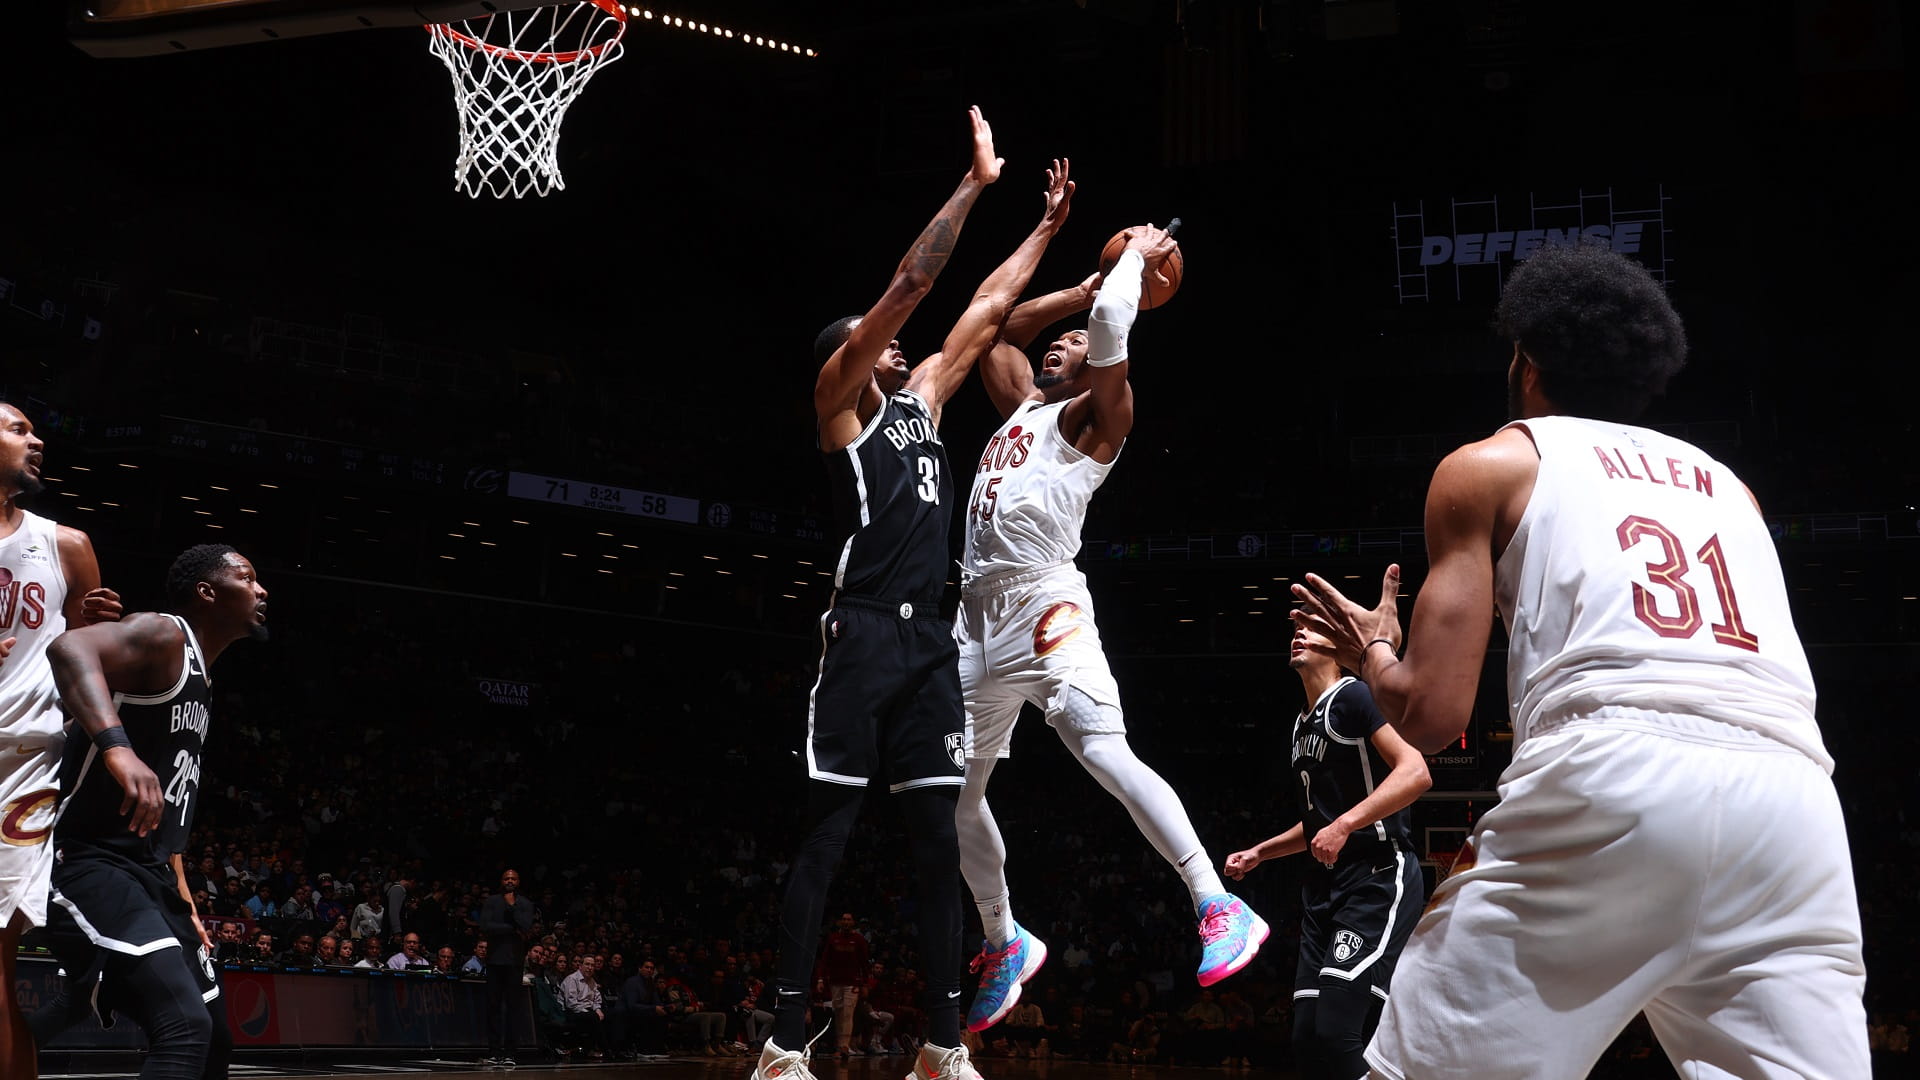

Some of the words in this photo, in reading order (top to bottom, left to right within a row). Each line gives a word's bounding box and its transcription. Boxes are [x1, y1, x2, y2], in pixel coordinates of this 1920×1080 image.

[1593, 446, 1713, 498] ALLEN
[545, 480, 570, 500] 71
[590, 486, 621, 501] 8:24
[642, 495, 666, 514] 58
[1616, 514, 1759, 654] 31
[480, 680, 528, 697] QATAR
[1438, 756, 1475, 765] TISSOT
[1300, 769, 1314, 812] 2
